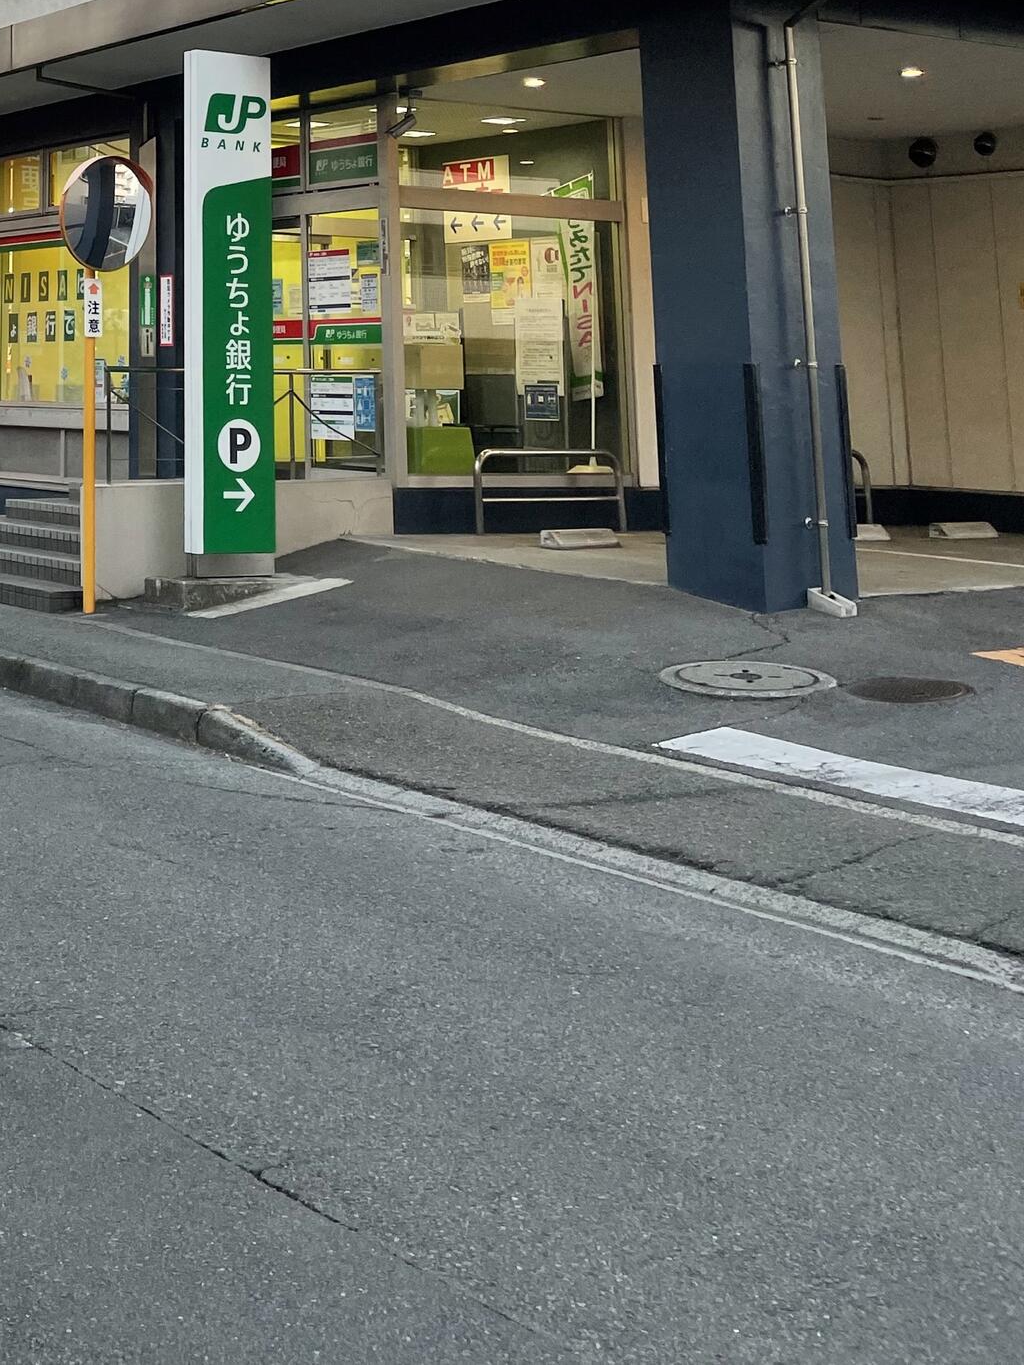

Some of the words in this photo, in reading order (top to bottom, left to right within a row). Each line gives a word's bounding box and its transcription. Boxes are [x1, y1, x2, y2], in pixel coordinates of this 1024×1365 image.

[204, 93, 267, 134] JP
[201, 137, 262, 153] BANK
[331, 155, 373, 172] ゆうちょ銀行
[443, 160, 492, 185] ATM
[87, 300, 101, 334] 注意
[226, 212, 252, 406] ゆうちょ銀行
[336, 329, 368, 340] ゆうちょ銀行
[229, 427, 252, 465] P
